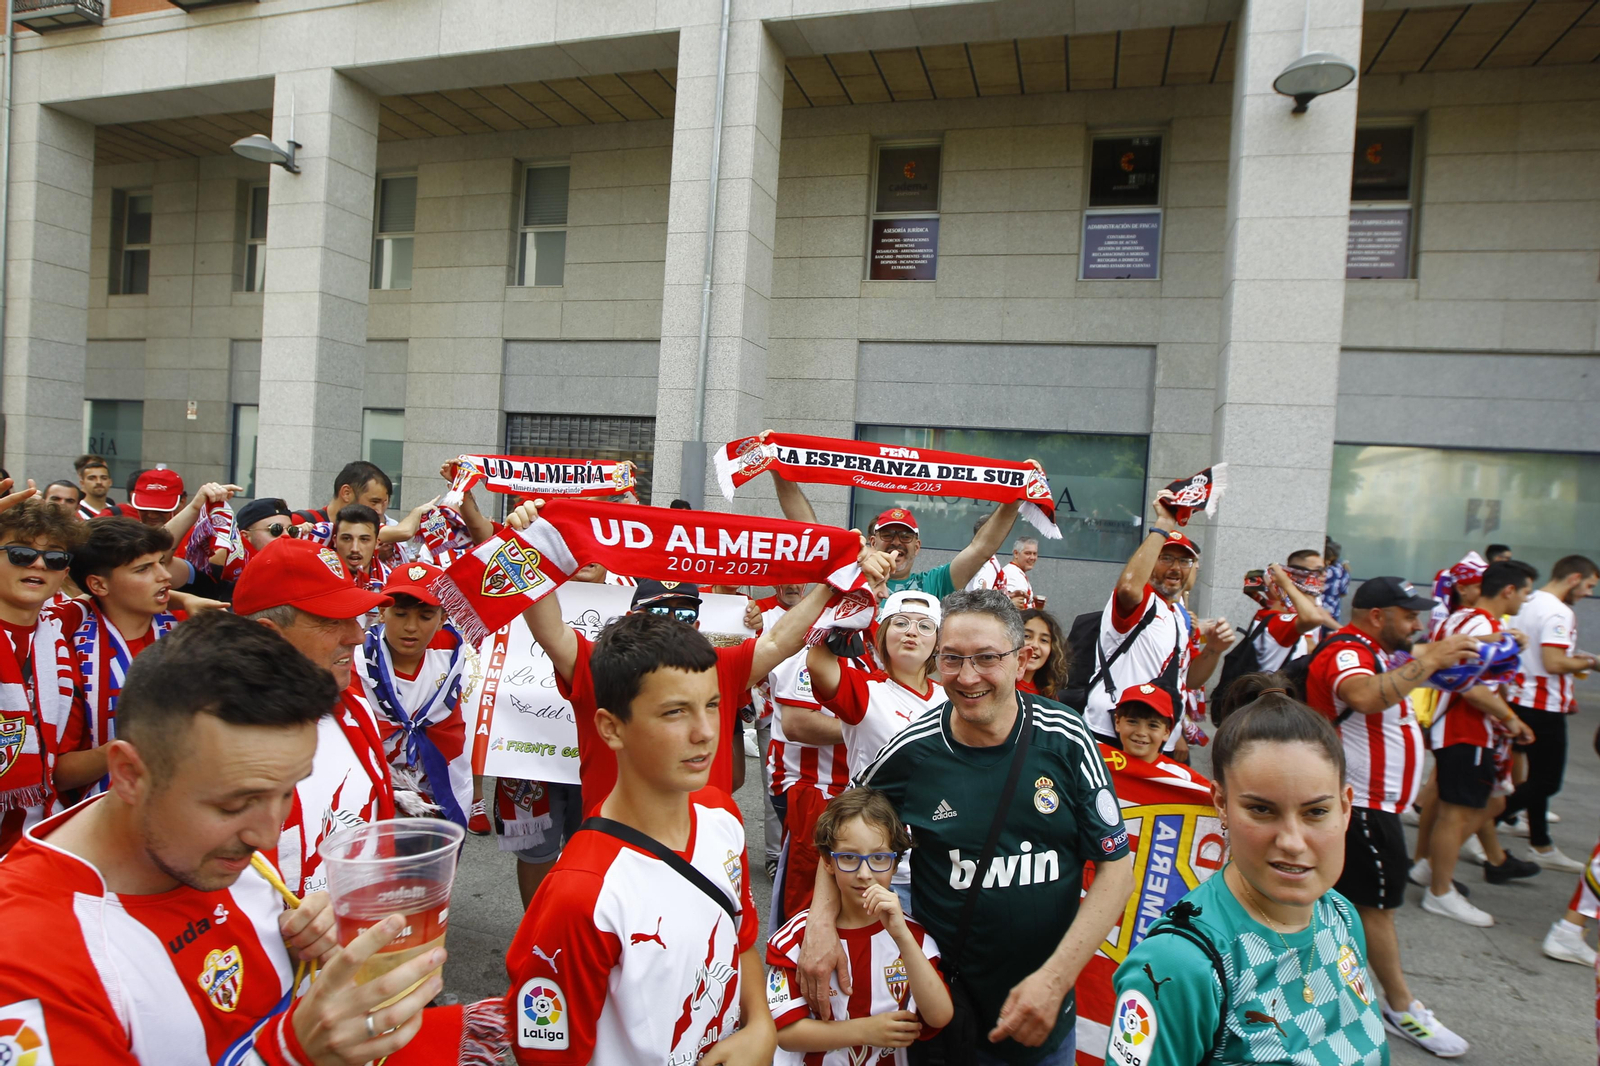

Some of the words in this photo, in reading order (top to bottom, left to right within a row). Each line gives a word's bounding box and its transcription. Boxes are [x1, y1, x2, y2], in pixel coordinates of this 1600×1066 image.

[880, 446, 920, 460] PEÑA
[482, 457, 514, 480] UD
[520, 460, 605, 484] ALMERÍA
[776, 447, 800, 466] LA
[805, 451, 932, 479] ESPERANZA
[937, 464, 977, 482] DEL
[983, 469, 1025, 487] SUR
[852, 474, 896, 491] Fundada
[896, 483, 911, 491] en
[908, 481, 942, 493] 2013
[589, 517, 654, 549] UD
[665, 525, 830, 562] ALMERÍA
[508, 546, 520, 558] U
[497, 556, 525, 589] ALMERIA
[525, 569, 536, 580] D
[667, 556, 769, 576] 2001-2021
[503, 666, 537, 686] La
[476, 642, 506, 736] ALMERIA
[536, 705, 566, 720] del
[506, 740, 557, 757] FRENTE
[932, 809, 958, 821] adidas
[948, 841, 1060, 890] bwin
[168, 917, 212, 954] uda
[768, 993, 789, 1005] LaLiga
[523, 1028, 565, 1042] LaLiga
[1113, 1036, 1142, 1066] LaLiga
